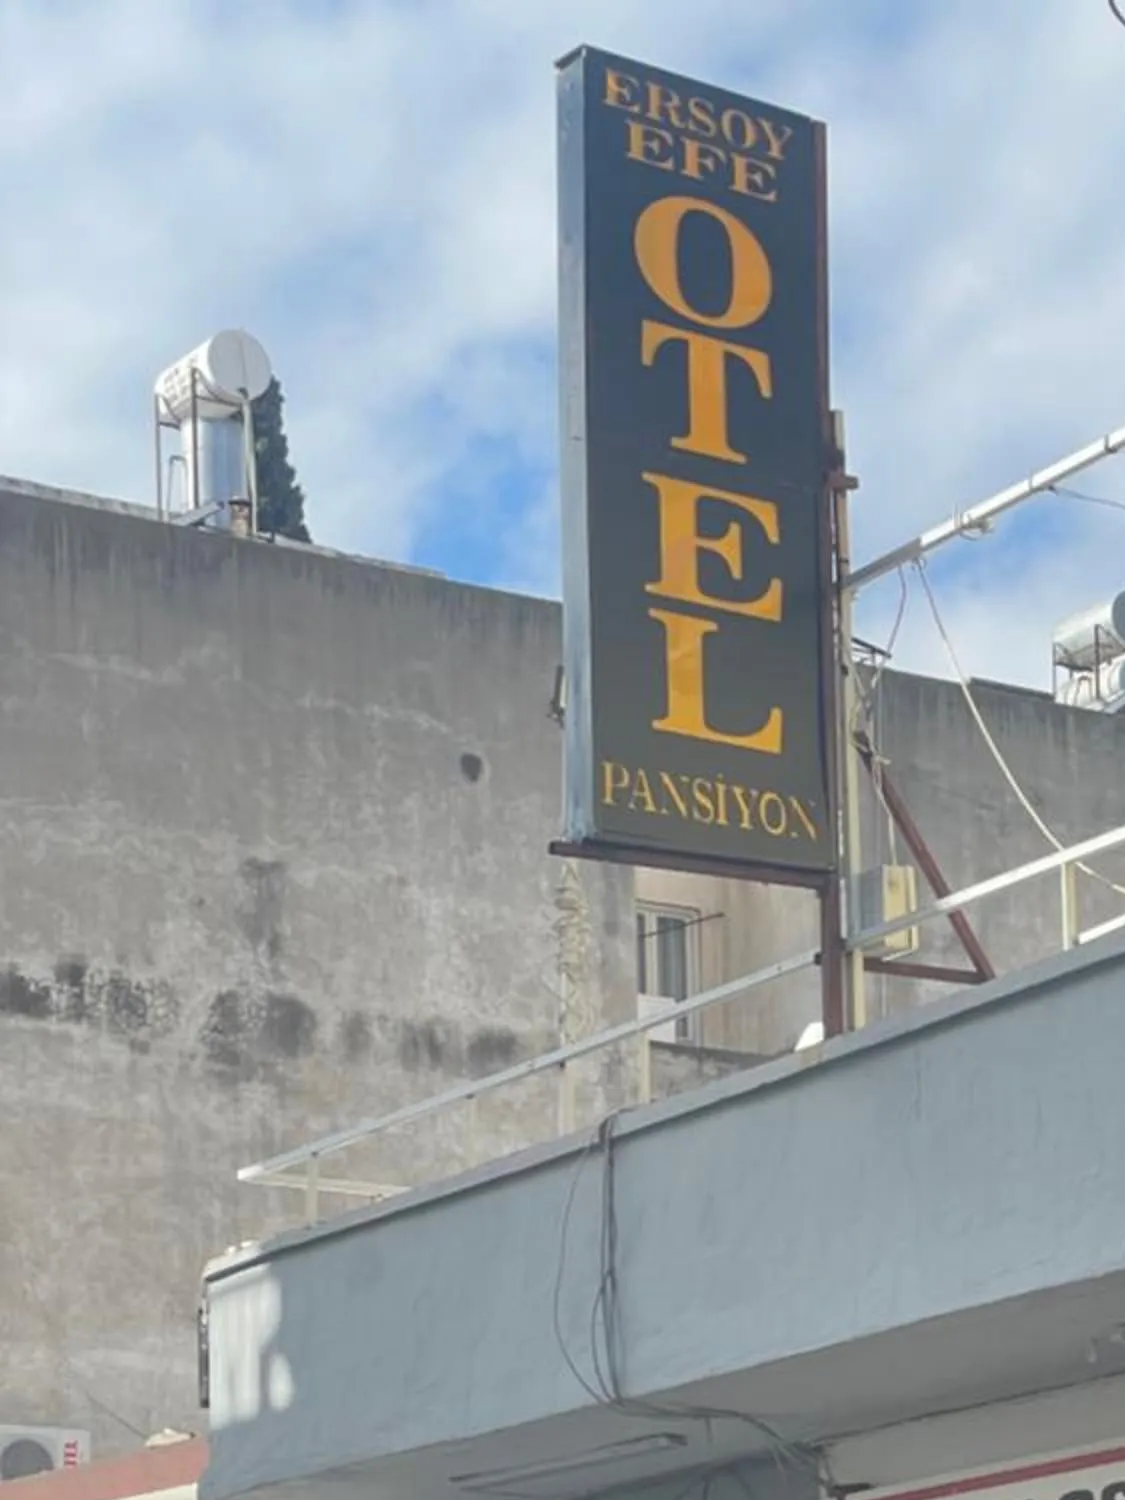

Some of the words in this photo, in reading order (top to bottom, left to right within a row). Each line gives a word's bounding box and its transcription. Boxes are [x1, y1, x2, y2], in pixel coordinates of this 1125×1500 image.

[603, 66, 793, 161] ERSOY
[625, 119, 778, 202] EFE
[633, 195, 783, 754] OTEL
